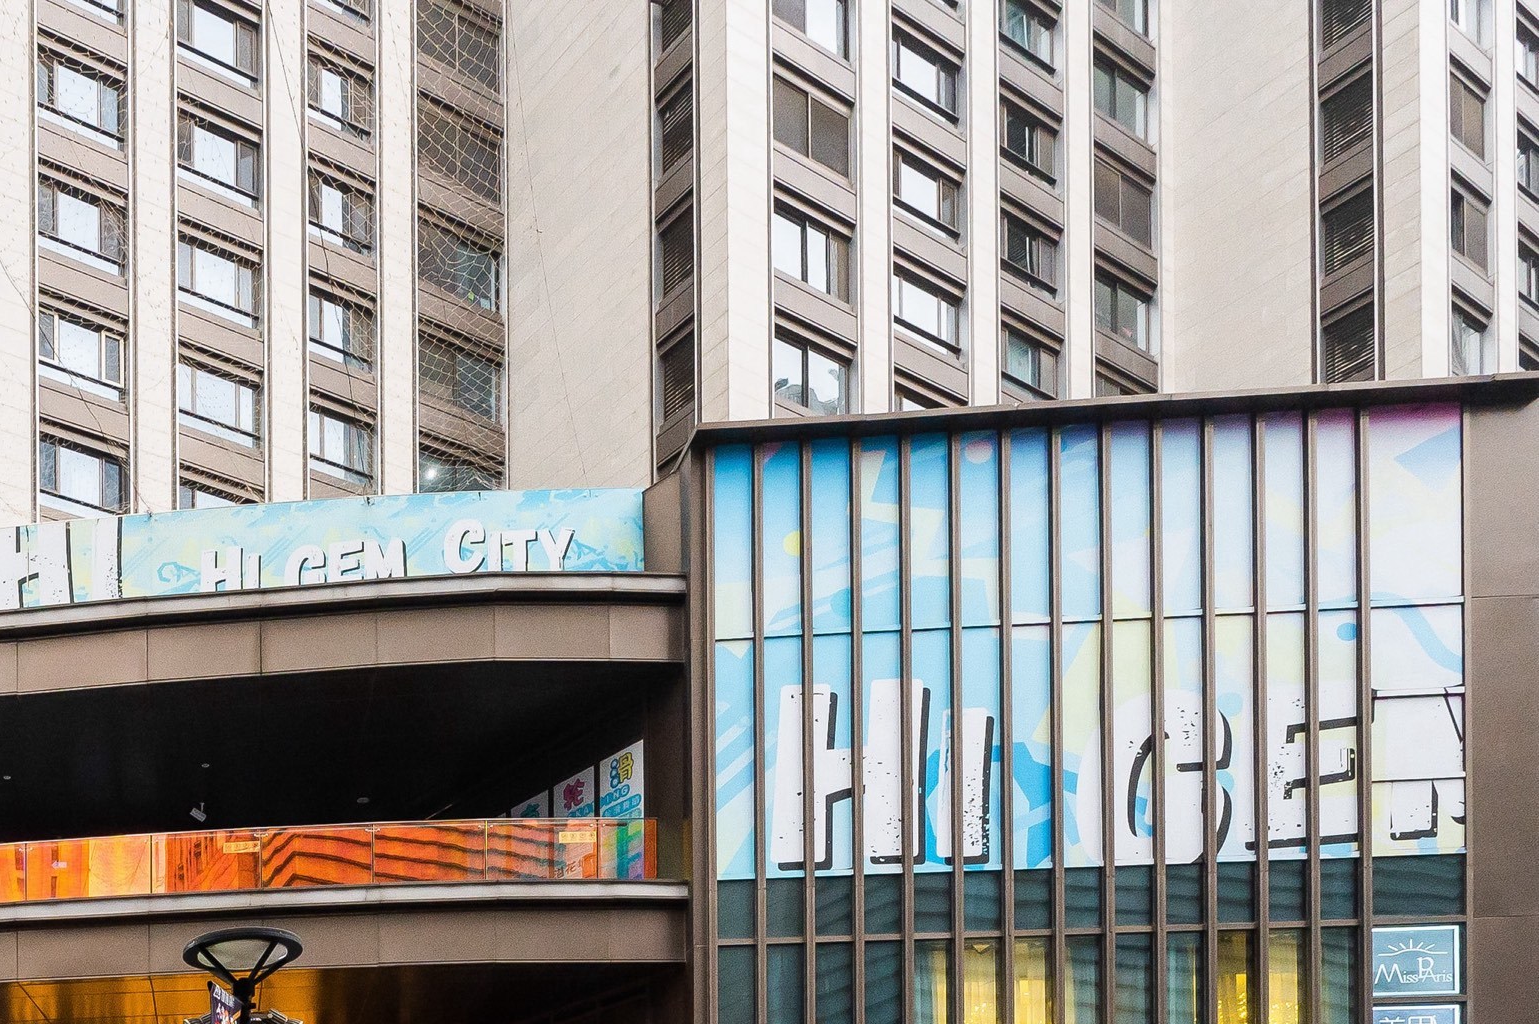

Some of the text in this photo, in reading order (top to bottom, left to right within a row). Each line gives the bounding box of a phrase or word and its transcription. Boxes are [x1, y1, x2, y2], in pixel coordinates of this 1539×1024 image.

[201, 519, 576, 594] HI GEM CITY
[769, 676, 996, 872] HI
[1375, 963, 1419, 985] Miss
